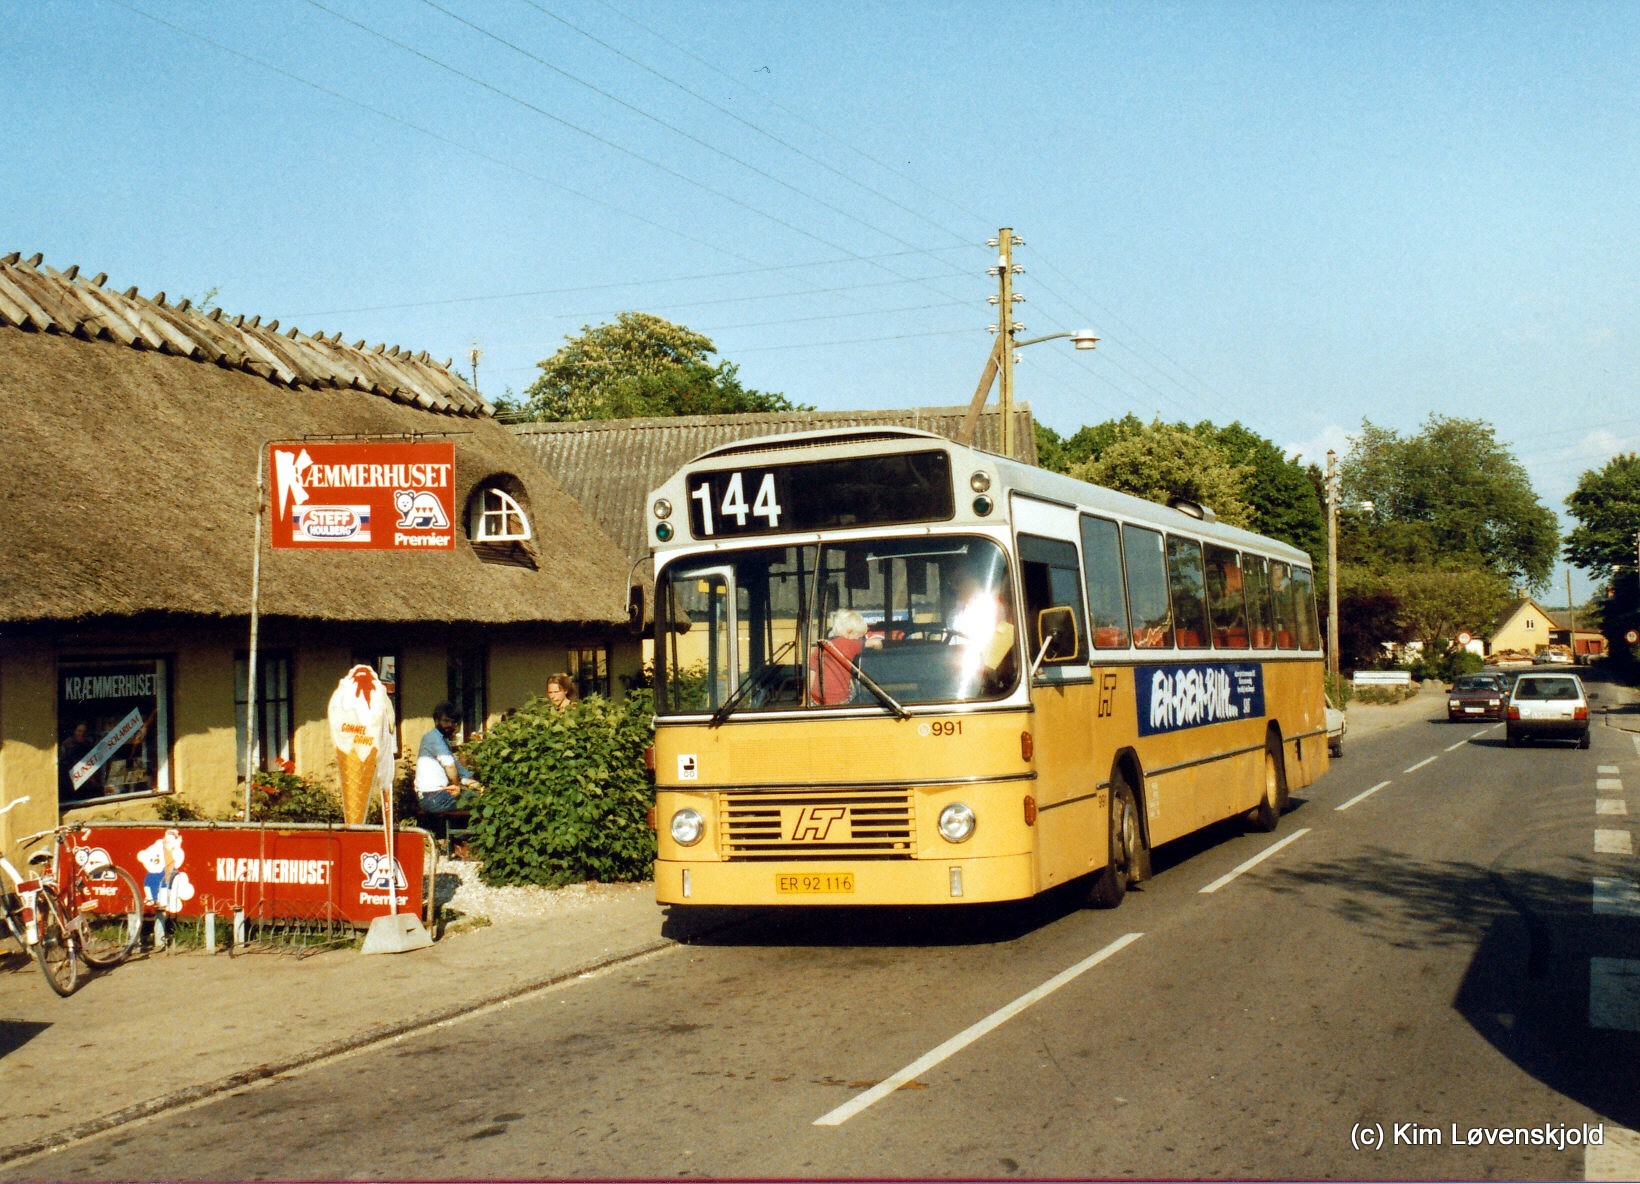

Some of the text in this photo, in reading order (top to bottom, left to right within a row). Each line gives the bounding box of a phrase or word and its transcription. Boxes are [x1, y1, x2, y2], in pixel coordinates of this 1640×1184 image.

[692, 472, 782, 536] 144
[309, 511, 350, 525] STEFF
[310, 525, 351, 535] HOULBERG
[395, 533, 450, 546] Premier
[65, 673, 158, 701] KRÆMMERHUSET
[931, 720, 962, 736] 991
[791, 807, 847, 841] HT
[216, 857, 334, 885] KRÆMMERHUSET
[780, 875, 852, 891] ER 92 116
[359, 891, 409, 906] Premer
